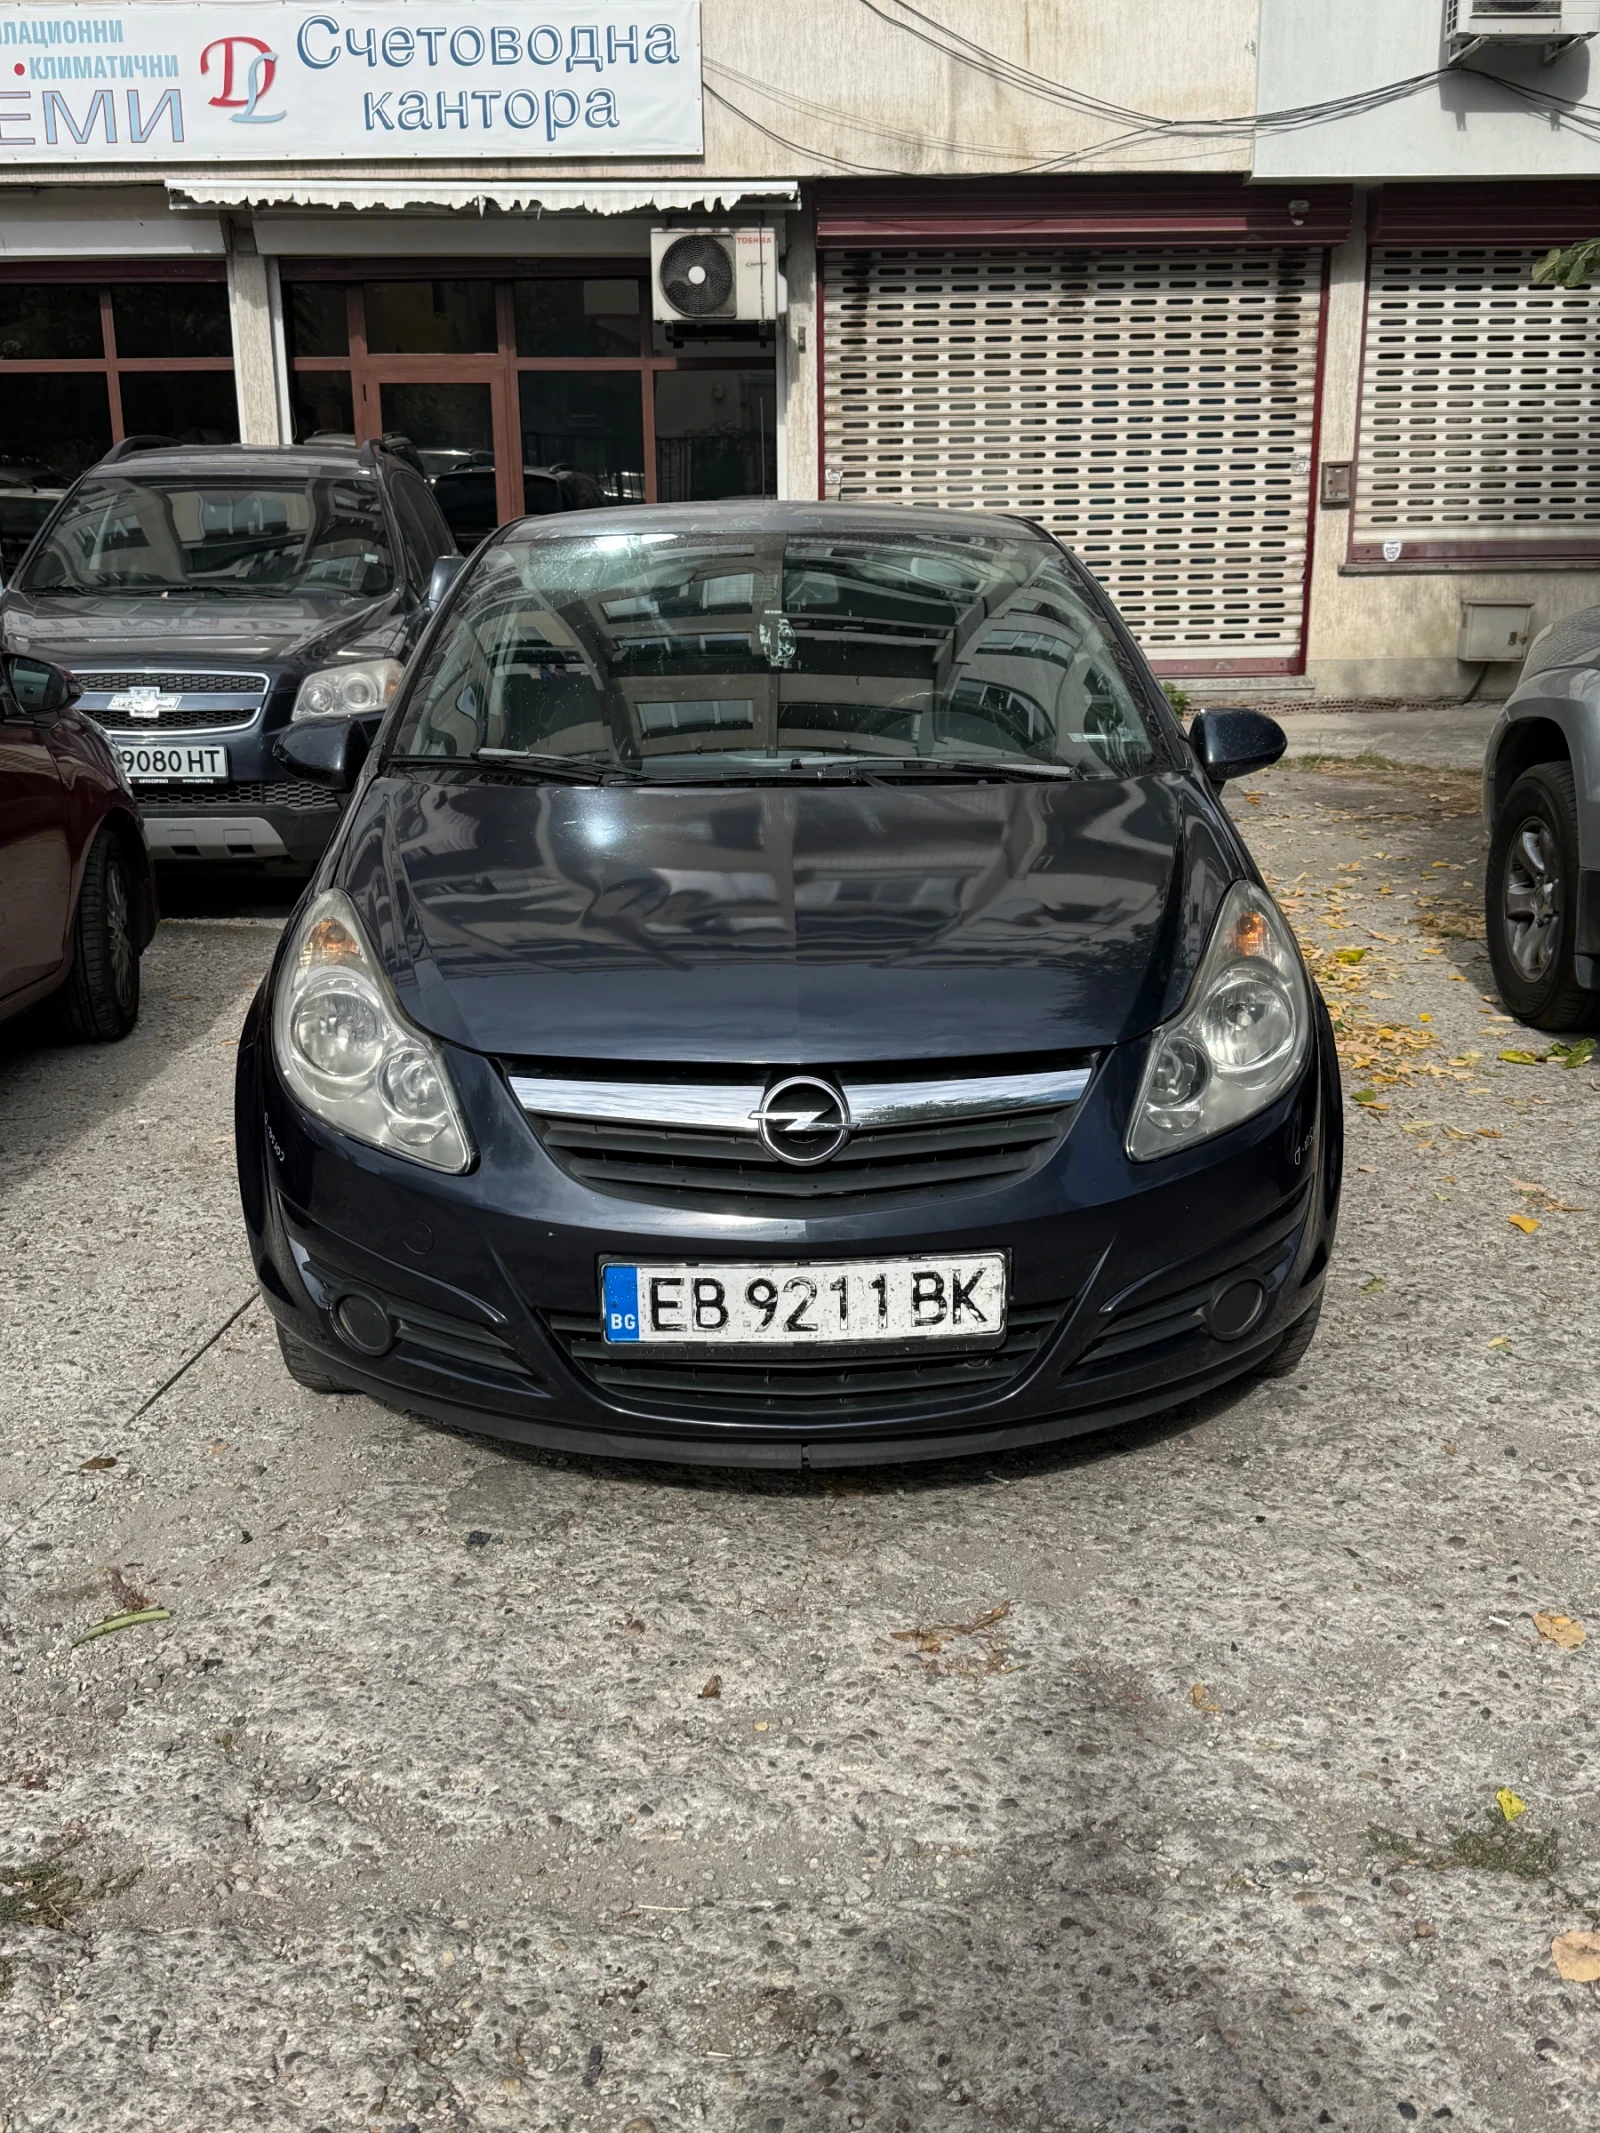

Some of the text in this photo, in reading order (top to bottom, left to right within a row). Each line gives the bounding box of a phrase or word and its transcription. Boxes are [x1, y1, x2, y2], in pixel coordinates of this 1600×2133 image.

[29, 54, 180, 80] КЛИМАТИЧНИ
[296, 14, 680, 73] Счетоводна
[0, 88, 186, 145] ЕМИ
[363, 86, 620, 142] кантора
[121, 750, 220, 773] 9080 HT
[610, 1312, 637, 1330] BG
[648, 1266, 989, 1333] EB 9211 BK
